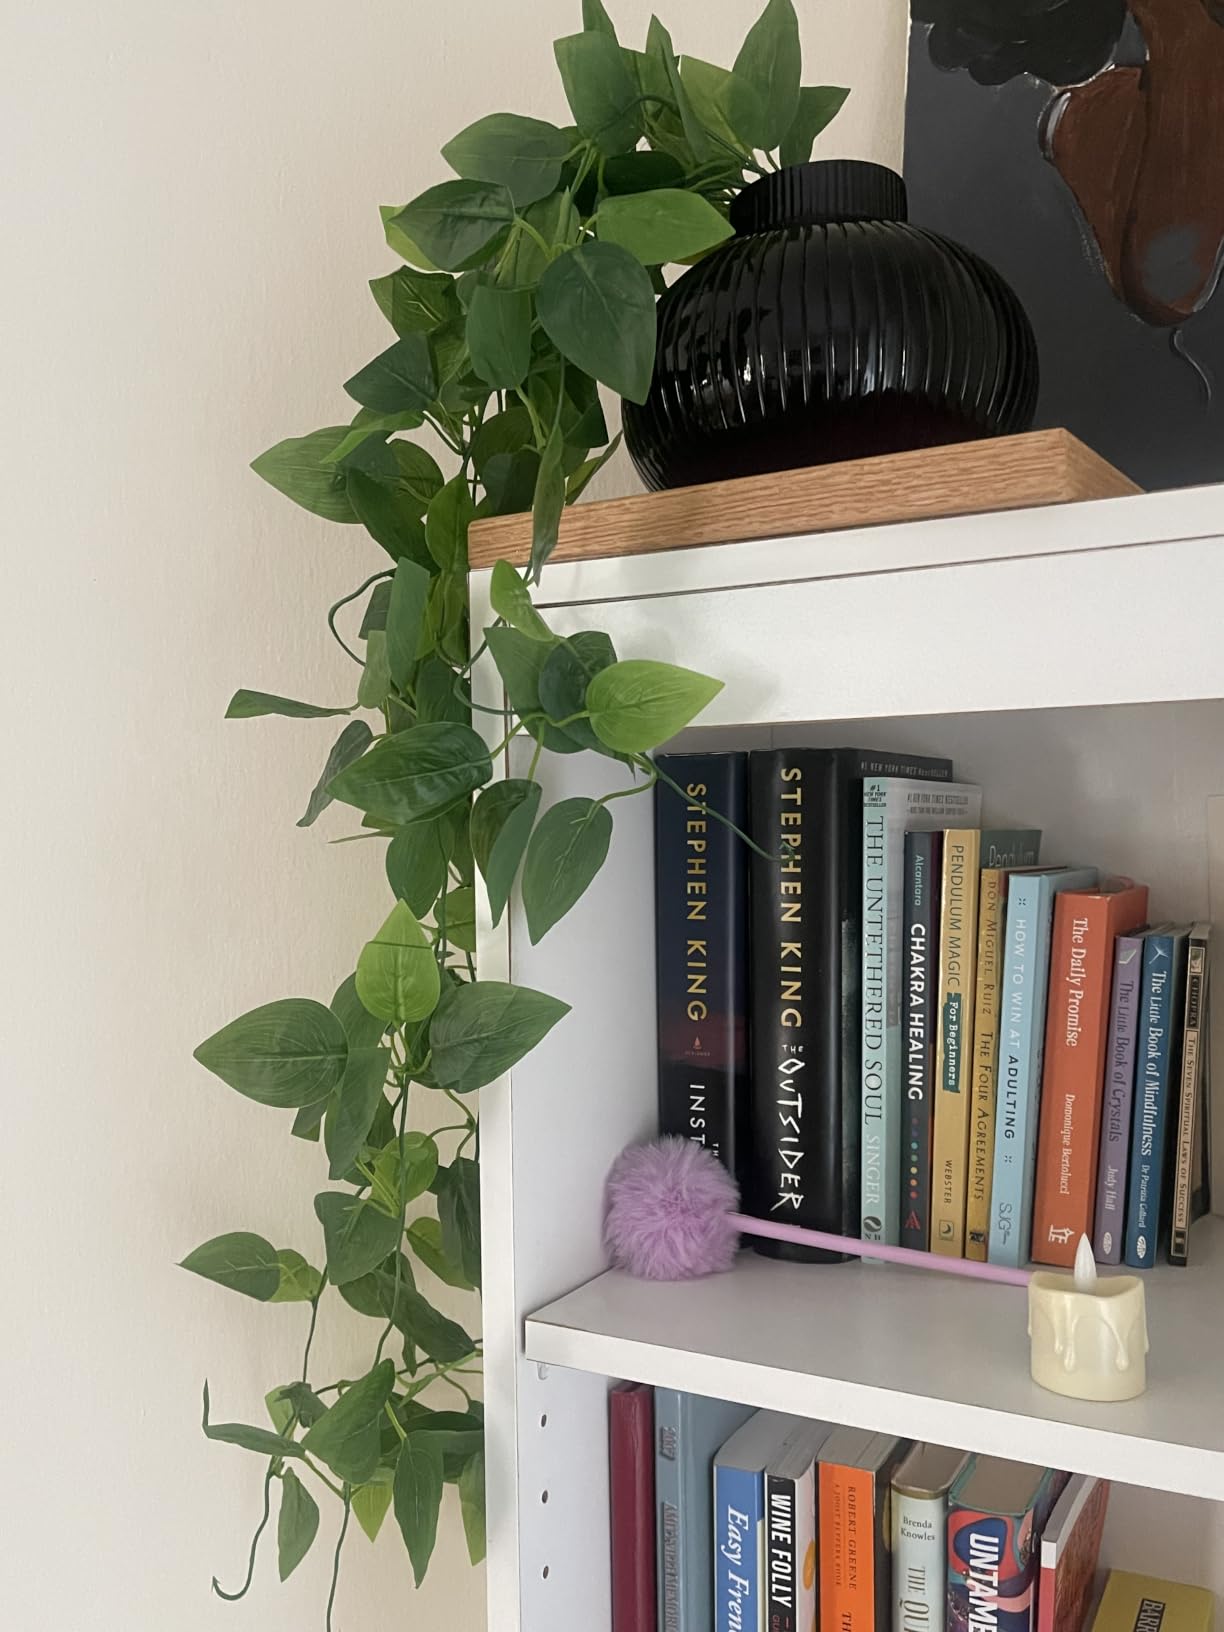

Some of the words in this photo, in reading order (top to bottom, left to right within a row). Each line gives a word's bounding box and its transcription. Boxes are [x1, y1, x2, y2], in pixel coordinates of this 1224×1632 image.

[870, 784, 880, 792] #1
[687, 783, 707, 920] STEPHEN
[780, 768, 802, 922] STEPHEN
[866, 816, 884, 868] THE
[914, 855, 925, 906] Alcantara
[949, 845, 965, 930] PENDULUM
[984, 919, 997, 976] MIGUEL
[1014, 919, 1026, 956] HOW
[1072, 918, 1088, 944] The
[687, 940, 707, 1021] KING
[864, 878, 884, 1050] UNTETHERED
[910, 923, 926, 1006] CHAKRA
[947, 937, 961, 987] MAGIC
[1012, 965, 1024, 985] TO
[1066, 948, 1087, 986] Daily
[1151, 970, 1167, 994] The
[780, 942, 802, 1028] KING
[982, 983, 995, 1014] RUIZ
[1119, 980, 1135, 1008] The
[1010, 992, 1023, 1024] WIN
[1066, 990, 1084, 1047] Promise
[1116, 1007, 1132, 1033] Little
[1149, 997, 1163, 1024] Little
[782, 1045, 804, 1053] THE
[908, 1013, 924, 1100] HEALING
[946, 1024, 959, 1086] Beginners
[980, 1032, 993, 1057] THE
[1008, 1031, 1020, 1048] AT
[1113, 1036, 1130, 1067] Book
[1147, 1027, 1163, 1059] Book
[1187, 1038, 1196, 1057] THE
[979, 1065, 992, 1101] FOUR
[1112, 1072, 1127, 1085] of
[1145, 1062, 1160, 1077] of
[1185, 1059, 1194, 1088] SEVEN
[864, 1059, 882, 1125] SOUL
[1004, 1055, 1019, 1139] ADULTING
[690, 1084, 706, 1146] INST
[770, 1058, 805, 1212] OUTSIDER
[1060, 1093, 1076, 1147] Domonique
[1107, 1088, 1127, 1143] Crystals
[1141, 1079, 1159, 1156] Mindfulness
[1182, 1092, 1192, 1136] SPIRITUAL
[865, 1135, 881, 1204] SINGER
[974, 1107, 990, 1201] AGREEMENTS
[1059, 1147, 1073, 1195] Bertolucci
[1142, 1164, 1150, 1174] Dr
[1179, 1168, 1187, 1178] OF
[1180, 1141, 1190, 1165] LAWS
[944, 1160, 953, 1204] WEBSTER
[1104, 1165, 1118, 1189] Judy
[1105, 1189, 1118, 1211] Hall
[1177, 1183, 1187, 1223] SUCCESS
[771, 1493, 791, 1545] WINE
[848, 1486, 857, 1533] ROBERT
[903, 1516, 932, 1529] Brenda
[721, 1504, 749, 1566] Easy
[900, 1528, 936, 1541] Knowles
[771, 1549, 792, 1608] FOLLY
[848, 1539, 857, 1591] GREENE
[908, 1566, 926, 1596] THE
[968, 1533, 1000, 1632] UNTAME
[727, 1570, 750, 1632] Fren
[841, 1611, 852, 1632] TH
[899, 1598, 930, 1632] QU
[1136, 1600, 1163, 1632] BARR
